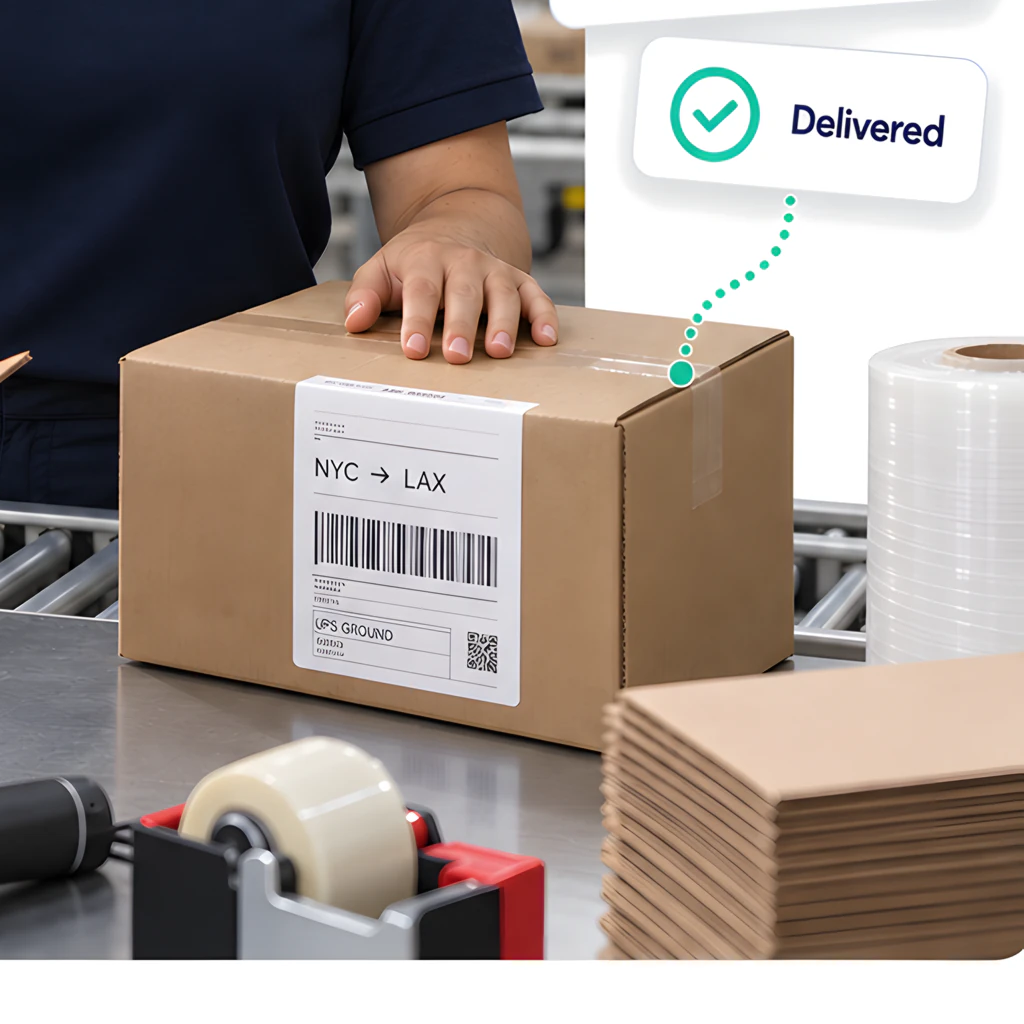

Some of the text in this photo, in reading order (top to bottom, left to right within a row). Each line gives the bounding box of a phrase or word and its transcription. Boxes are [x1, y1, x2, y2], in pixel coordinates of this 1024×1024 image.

[315, 458, 447, 494] NYC LAX
[341, 621, 394, 642] GROUND
